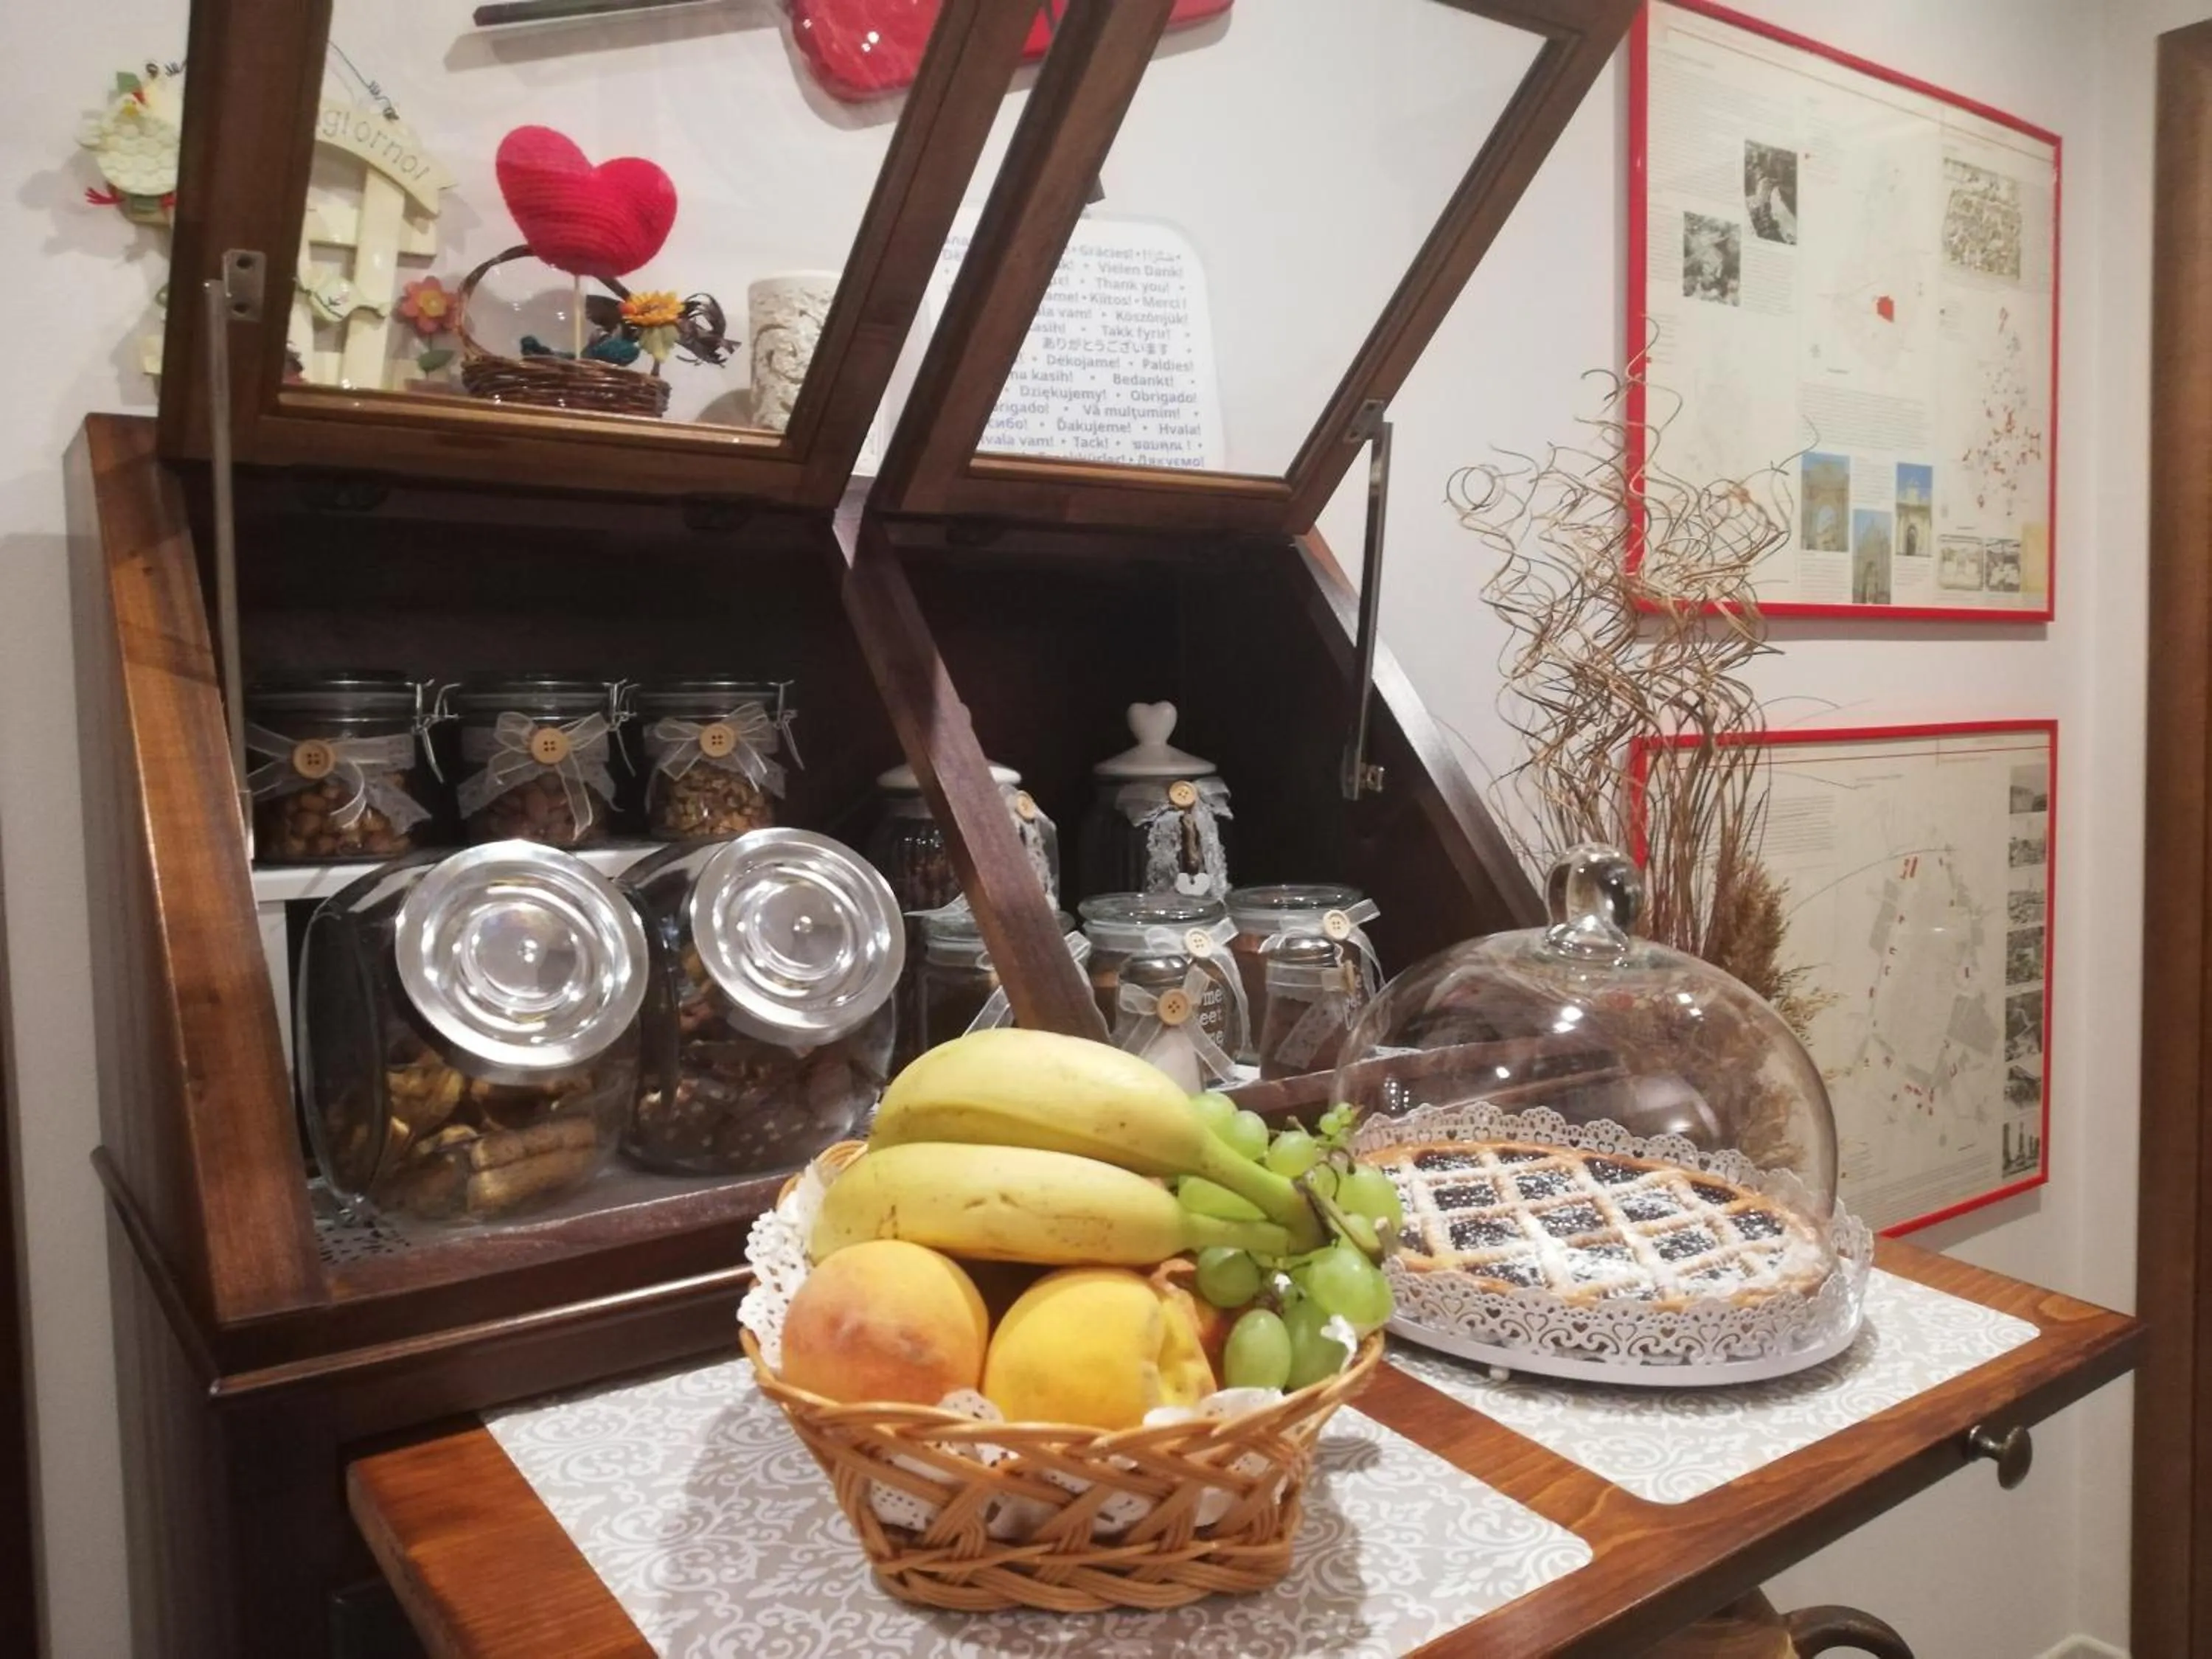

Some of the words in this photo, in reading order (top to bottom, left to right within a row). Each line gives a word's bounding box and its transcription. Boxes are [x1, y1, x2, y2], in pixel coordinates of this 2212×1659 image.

[1097, 261, 1141, 275] Vielen
[1096, 276, 1138, 291] Thank
[1101, 324, 1134, 337] Takk
[1142, 358, 1194, 372] Paldies!
[1113, 372, 1174, 387] Bedankt!
[1020, 385, 1107, 403] Dziękujemy!
[1130, 389, 1197, 406] Obrigado!
[1158, 422, 1201, 437] Hvala!
[1073, 436, 1109, 449] Tack!
